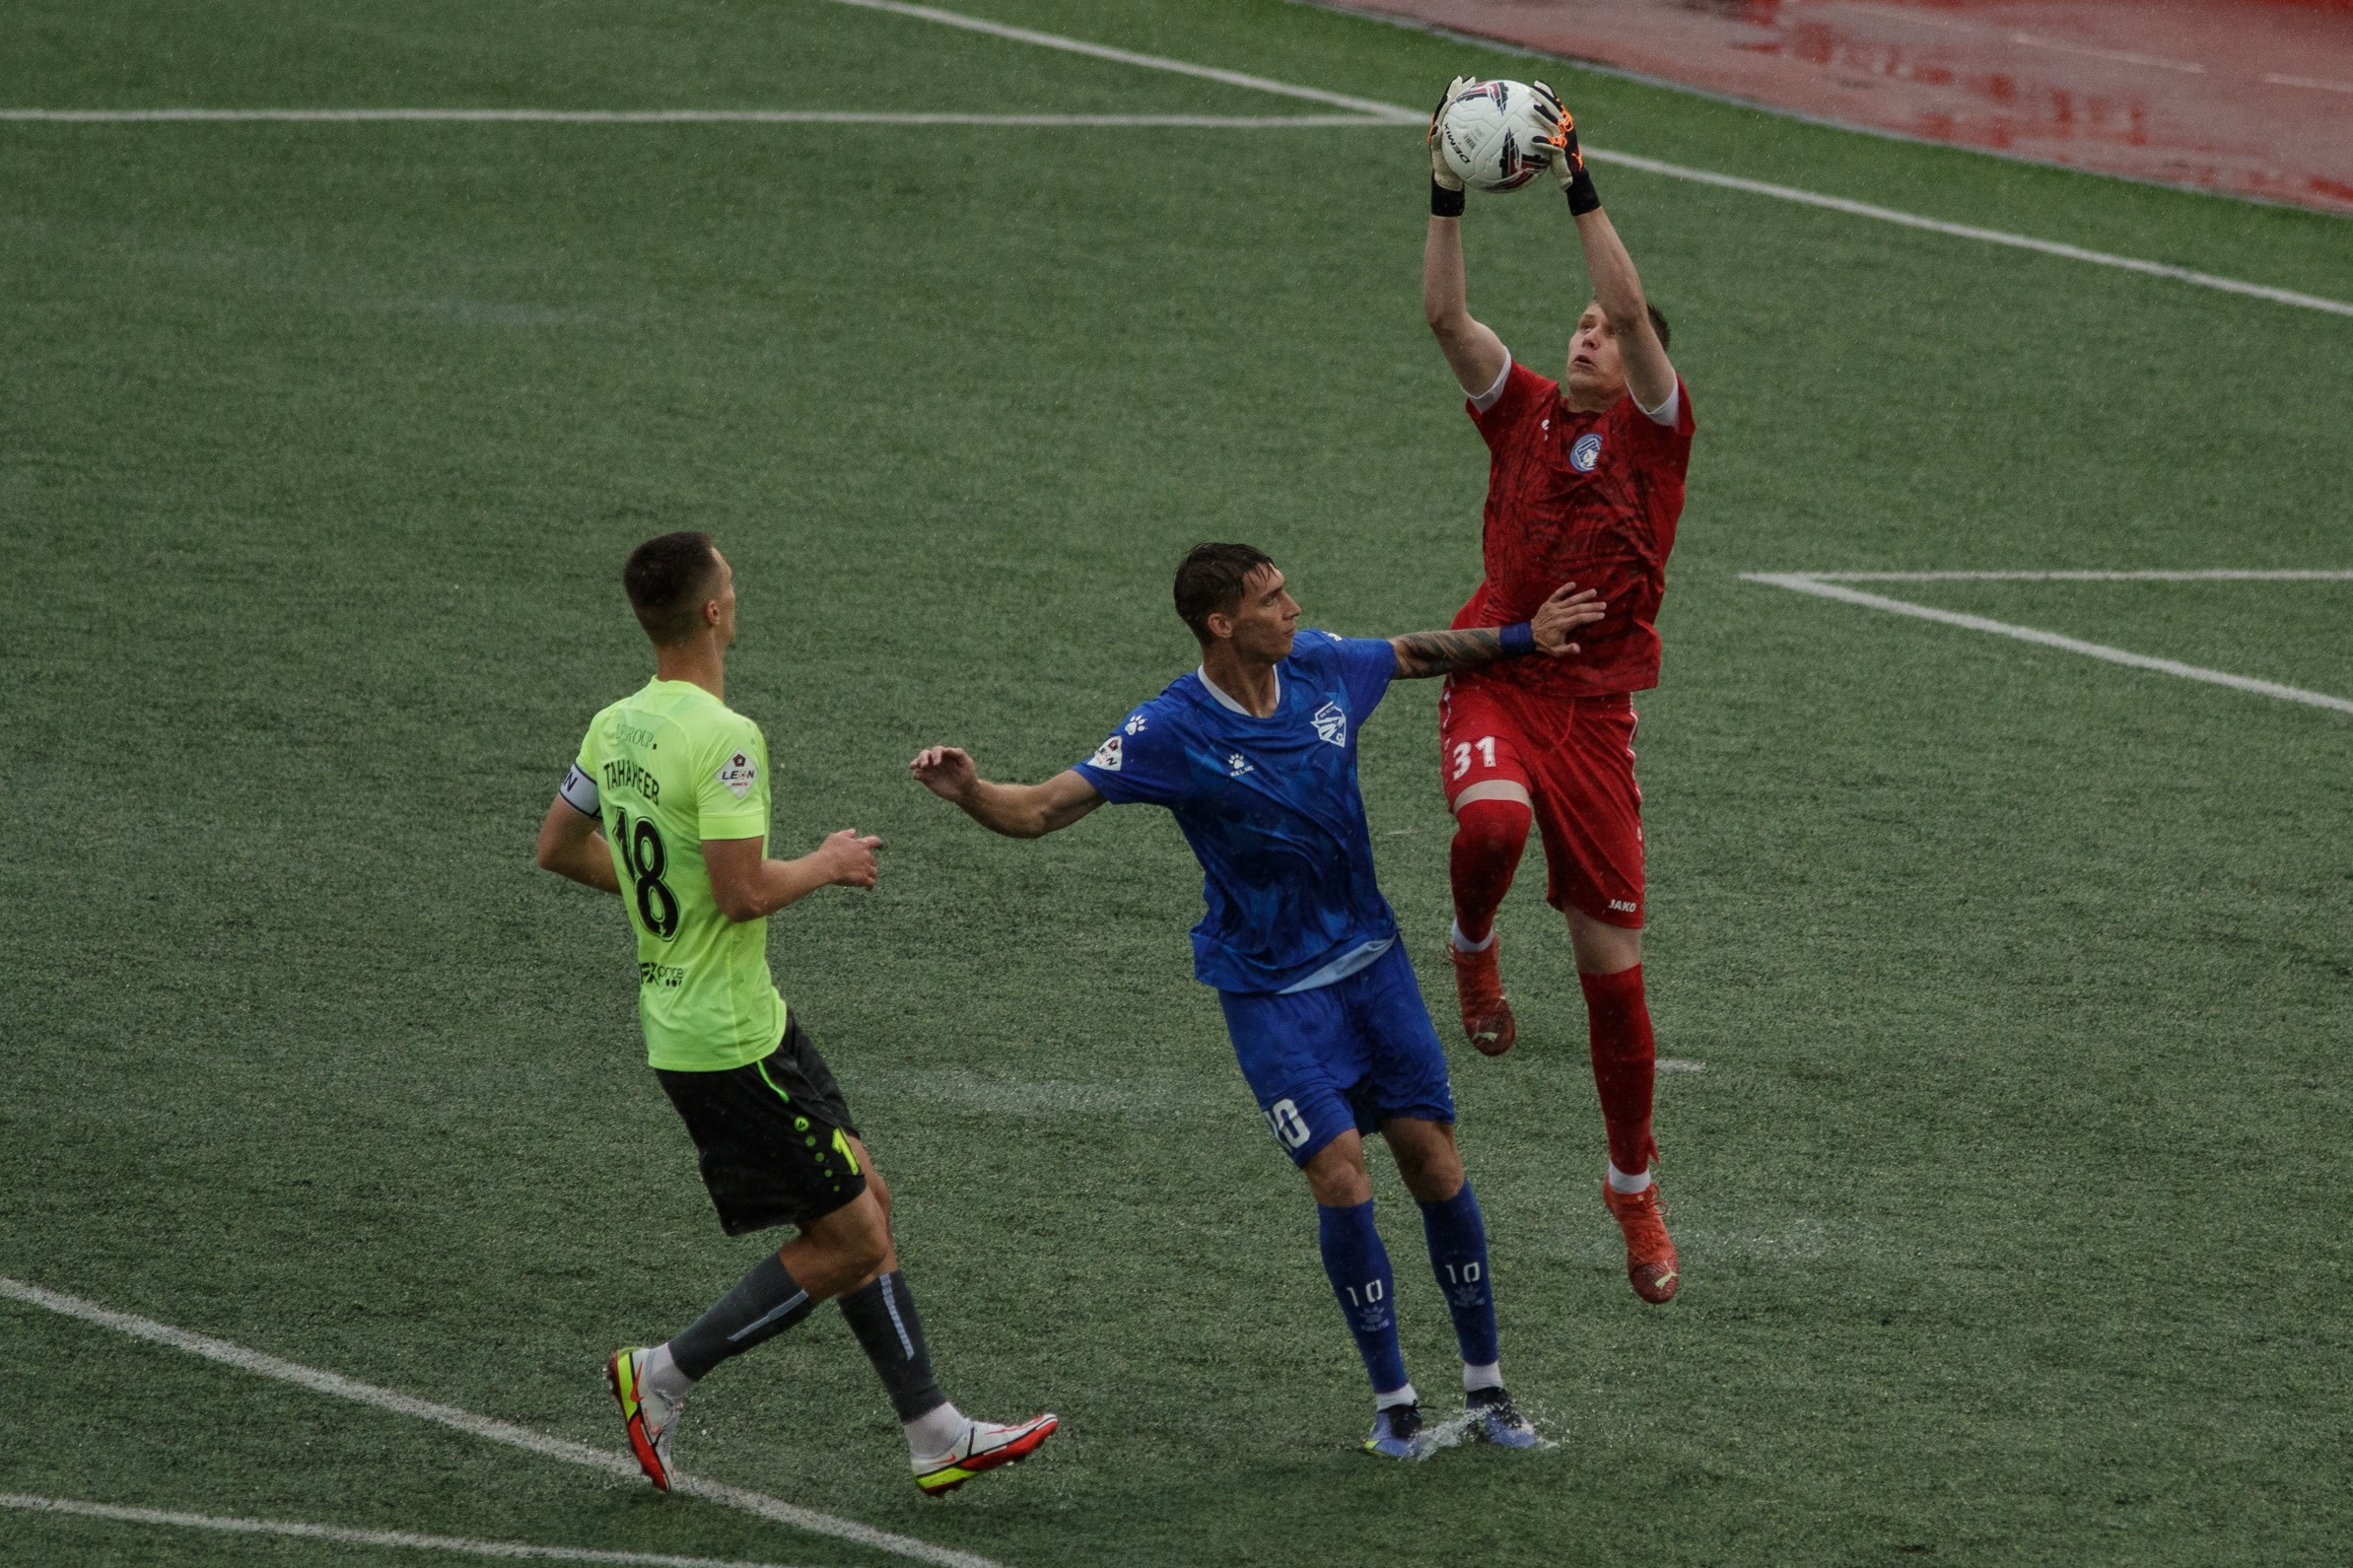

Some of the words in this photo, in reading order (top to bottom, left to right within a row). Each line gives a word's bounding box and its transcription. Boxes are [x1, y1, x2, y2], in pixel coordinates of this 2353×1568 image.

[1452, 735, 1497, 782] 31
[612, 806, 680, 942] 18
[1608, 898, 1637, 914] JAKO
[1445, 1261, 1481, 1285] 10
[1346, 1278, 1383, 1308] 10
